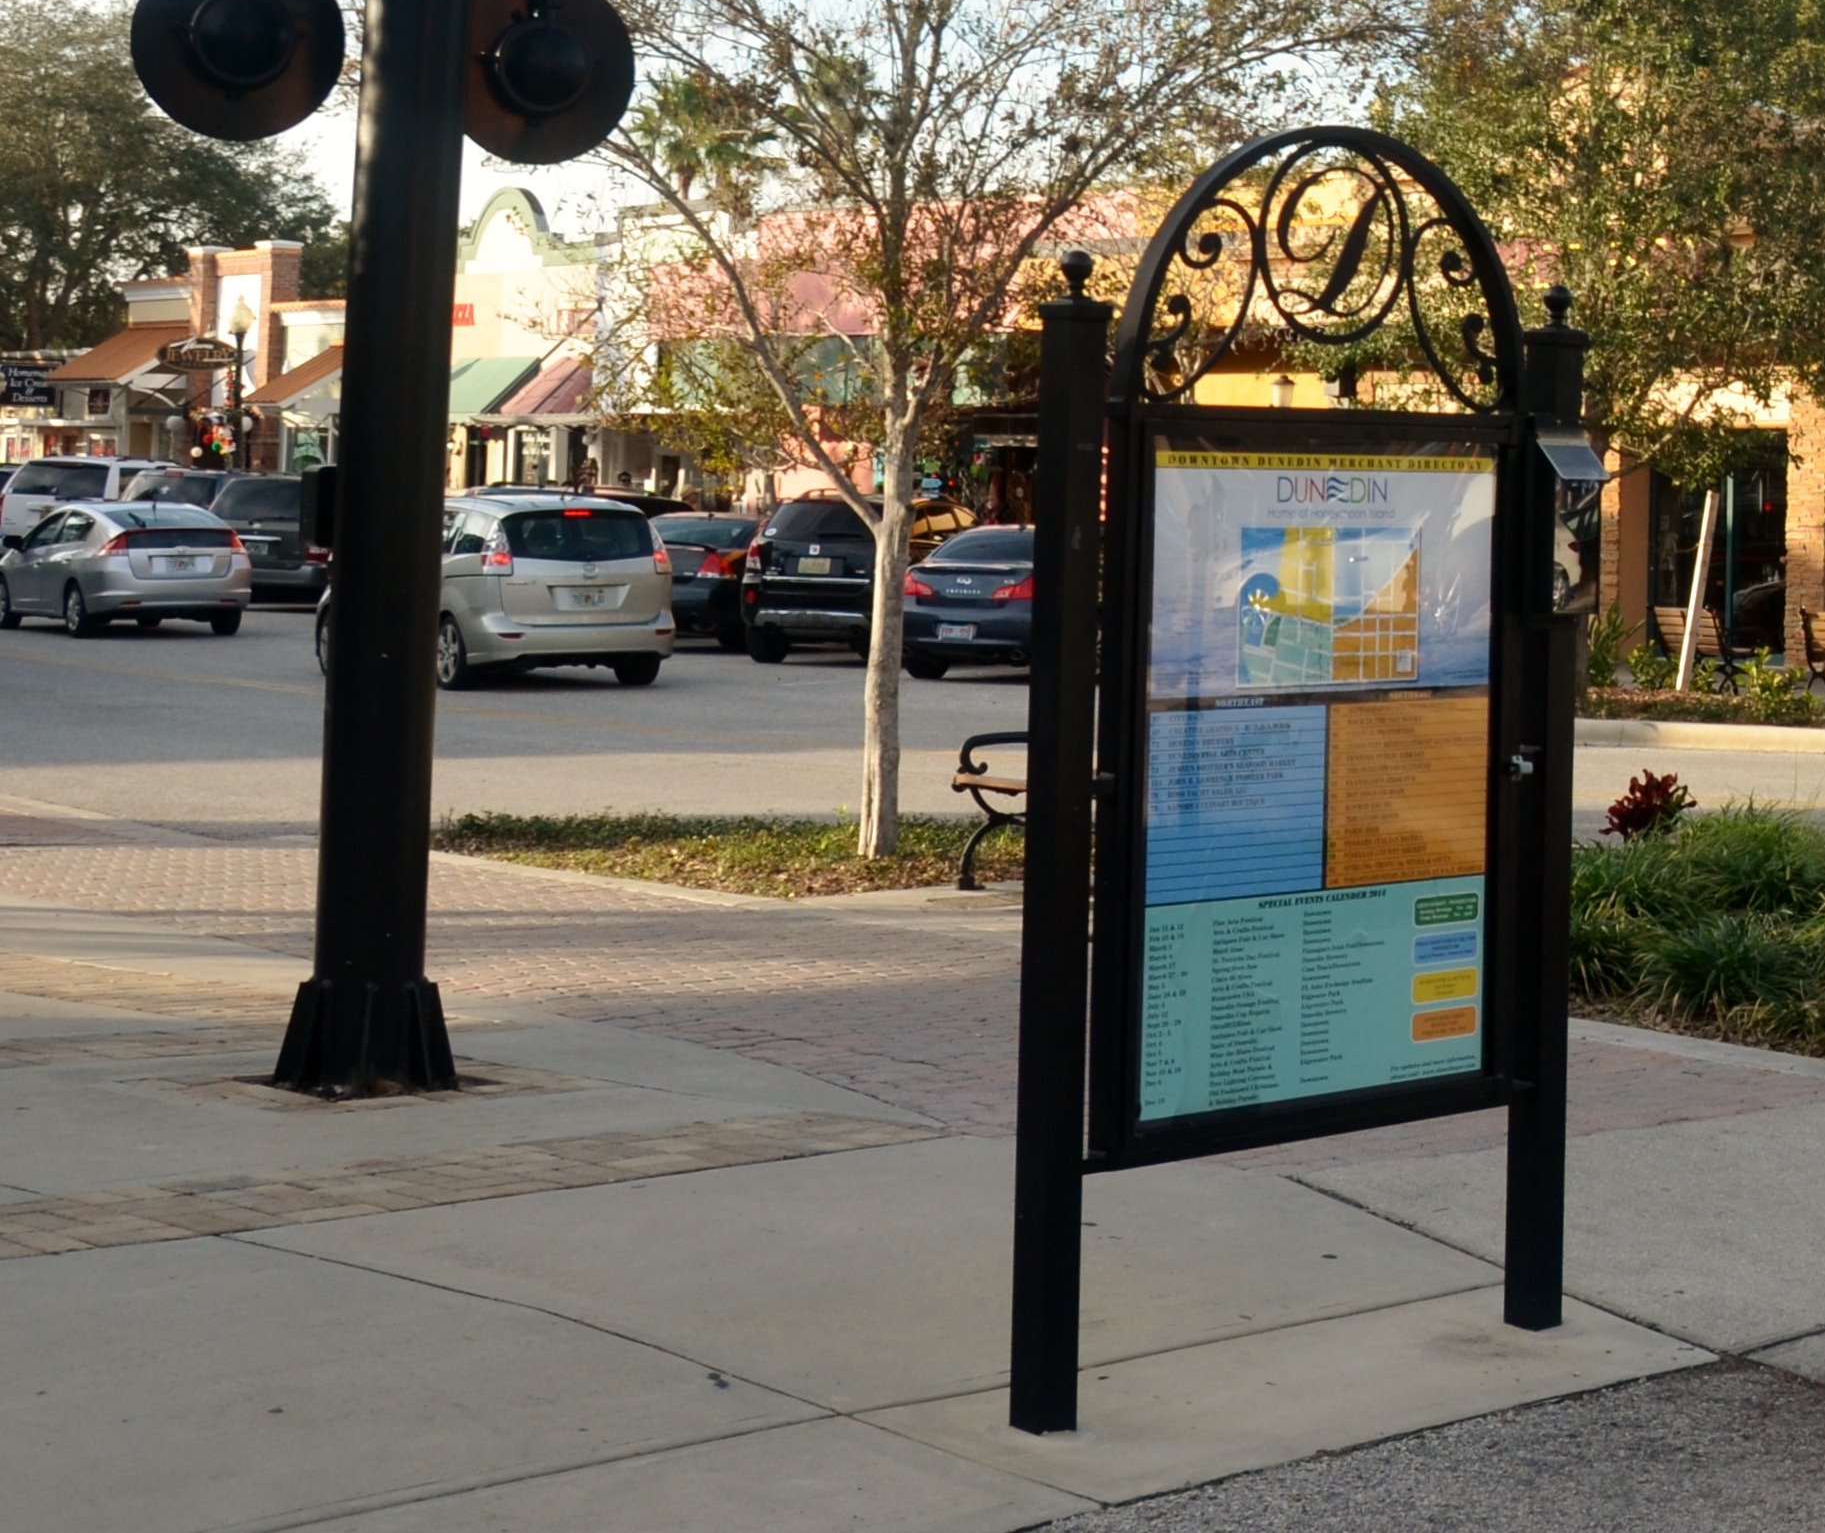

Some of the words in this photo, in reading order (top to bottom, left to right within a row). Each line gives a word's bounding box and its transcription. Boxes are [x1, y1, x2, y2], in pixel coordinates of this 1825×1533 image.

[167, 347, 233, 362] JEWELRY
[10, 378, 22, 387] Ice
[12, 393, 48, 402] Desserts
[1168, 455, 1250, 467] DOWNTOWN
[1258, 456, 1321, 468] DUNEDIN
[1329, 458, 1402, 470] MERCHANT
[1408, 459, 1483, 471] DIRECTORY
[1277, 476, 1388, 503] DUNEDIN
[1268, 509, 1296, 519] Home
[1310, 509, 1366, 521] Honeymoon
[1370, 509, 1395, 519] Island
[1215, 698, 1265, 708] NORTHEAST
[1258, 898, 1292, 909] SPECIAL
[1295, 896, 1324, 906] EVENTS
[1326, 890, 1367, 903] CALENDER
